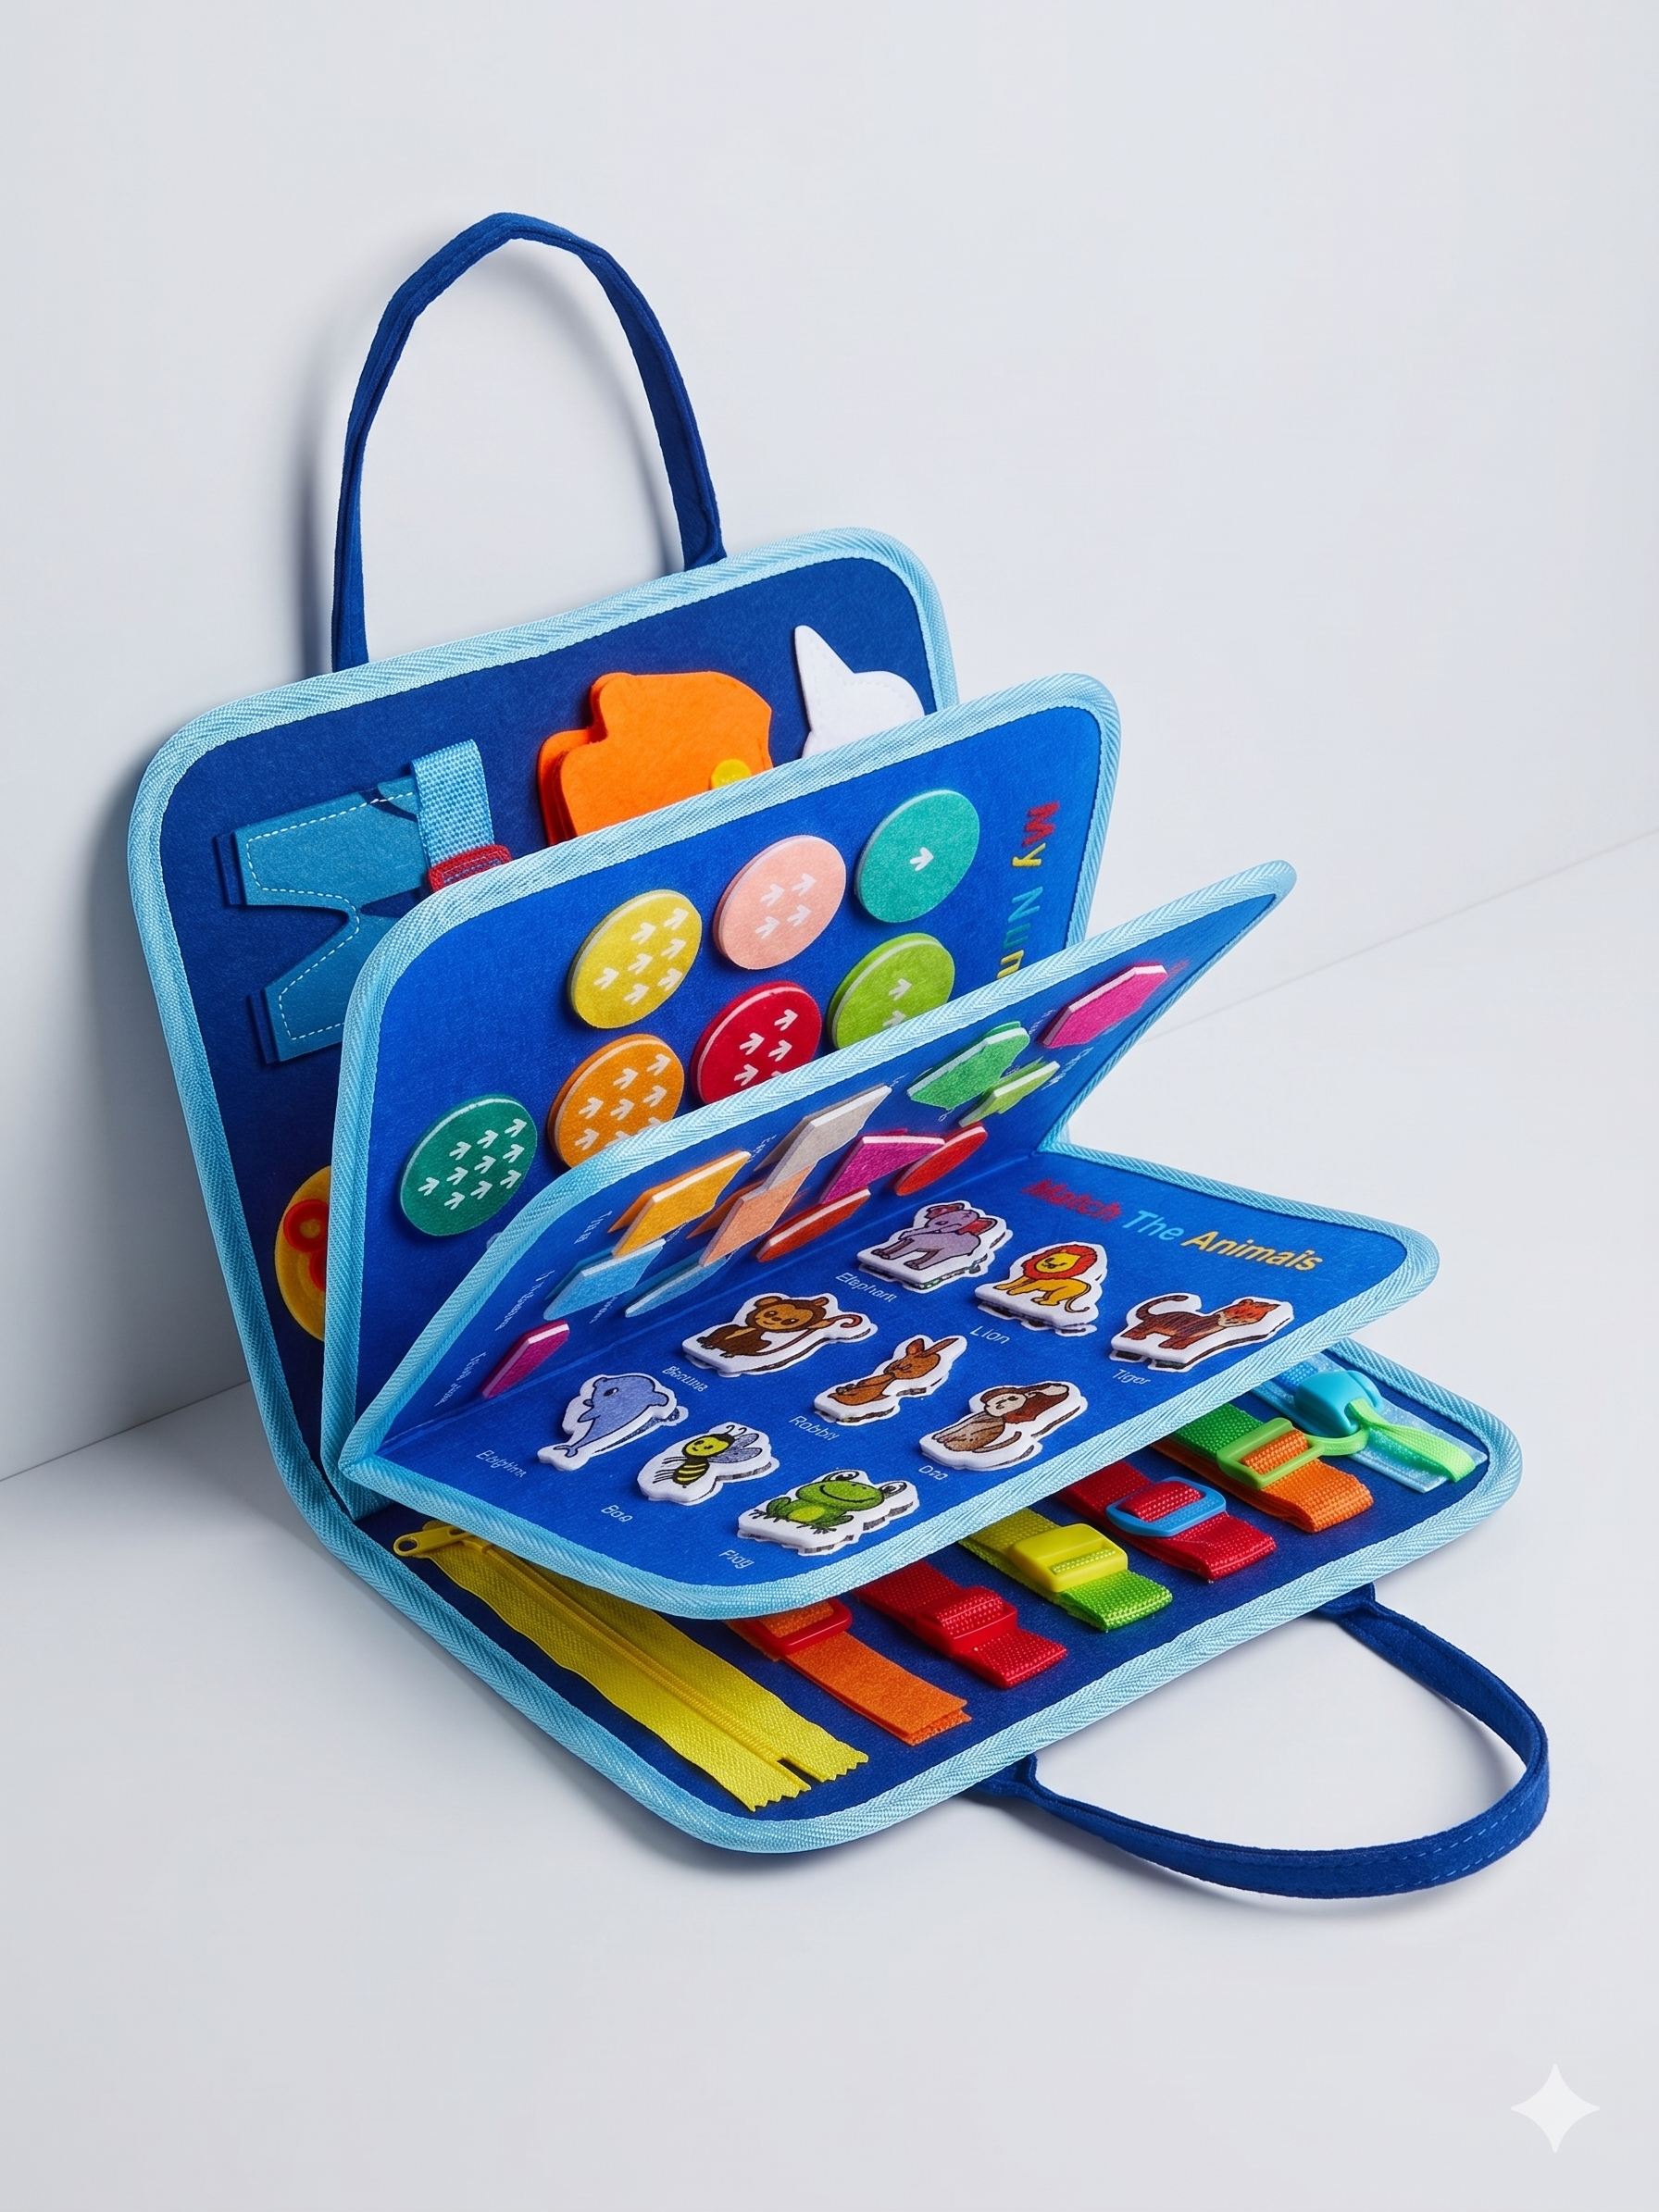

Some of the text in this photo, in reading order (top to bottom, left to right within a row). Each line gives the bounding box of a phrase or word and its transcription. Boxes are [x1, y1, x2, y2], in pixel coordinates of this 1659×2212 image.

[1011, 802, 1060, 867] My
[1020, 1178, 1122, 1223] Match
[1121, 1210, 1185, 1241] The
